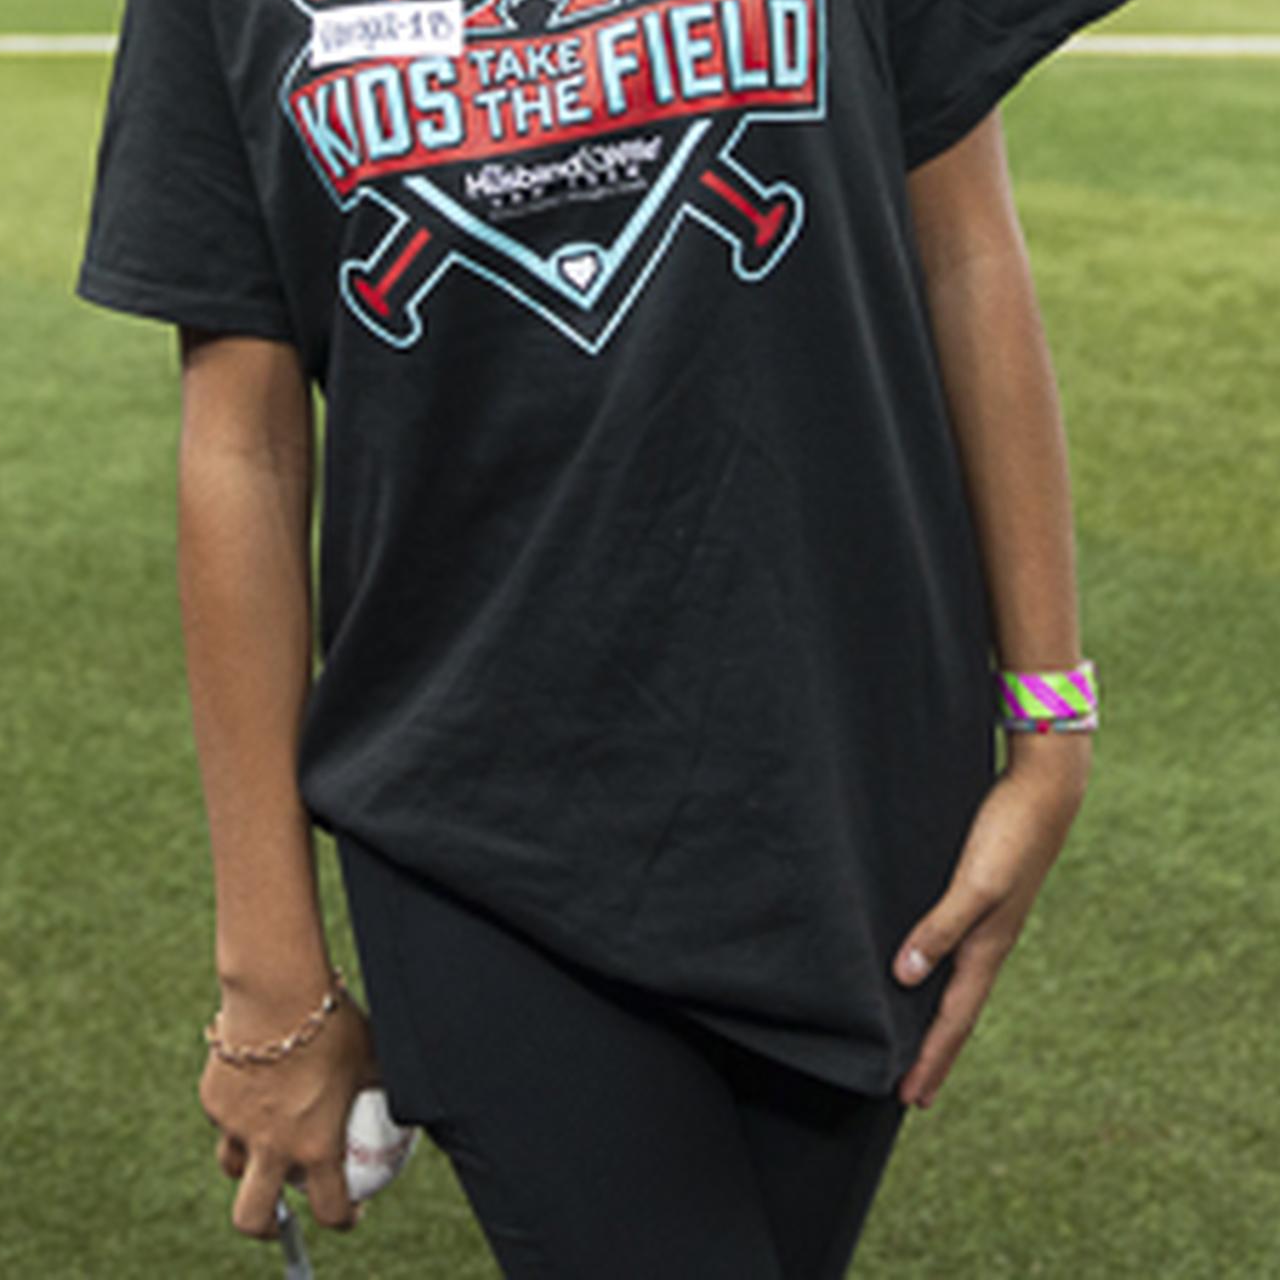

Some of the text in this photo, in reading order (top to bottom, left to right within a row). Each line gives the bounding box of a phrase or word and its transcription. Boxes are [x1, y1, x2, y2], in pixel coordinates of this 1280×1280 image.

[468, 37, 583, 88] TAKE
[297, 56, 464, 179] KIDS
[473, 74, 593, 141] THE
